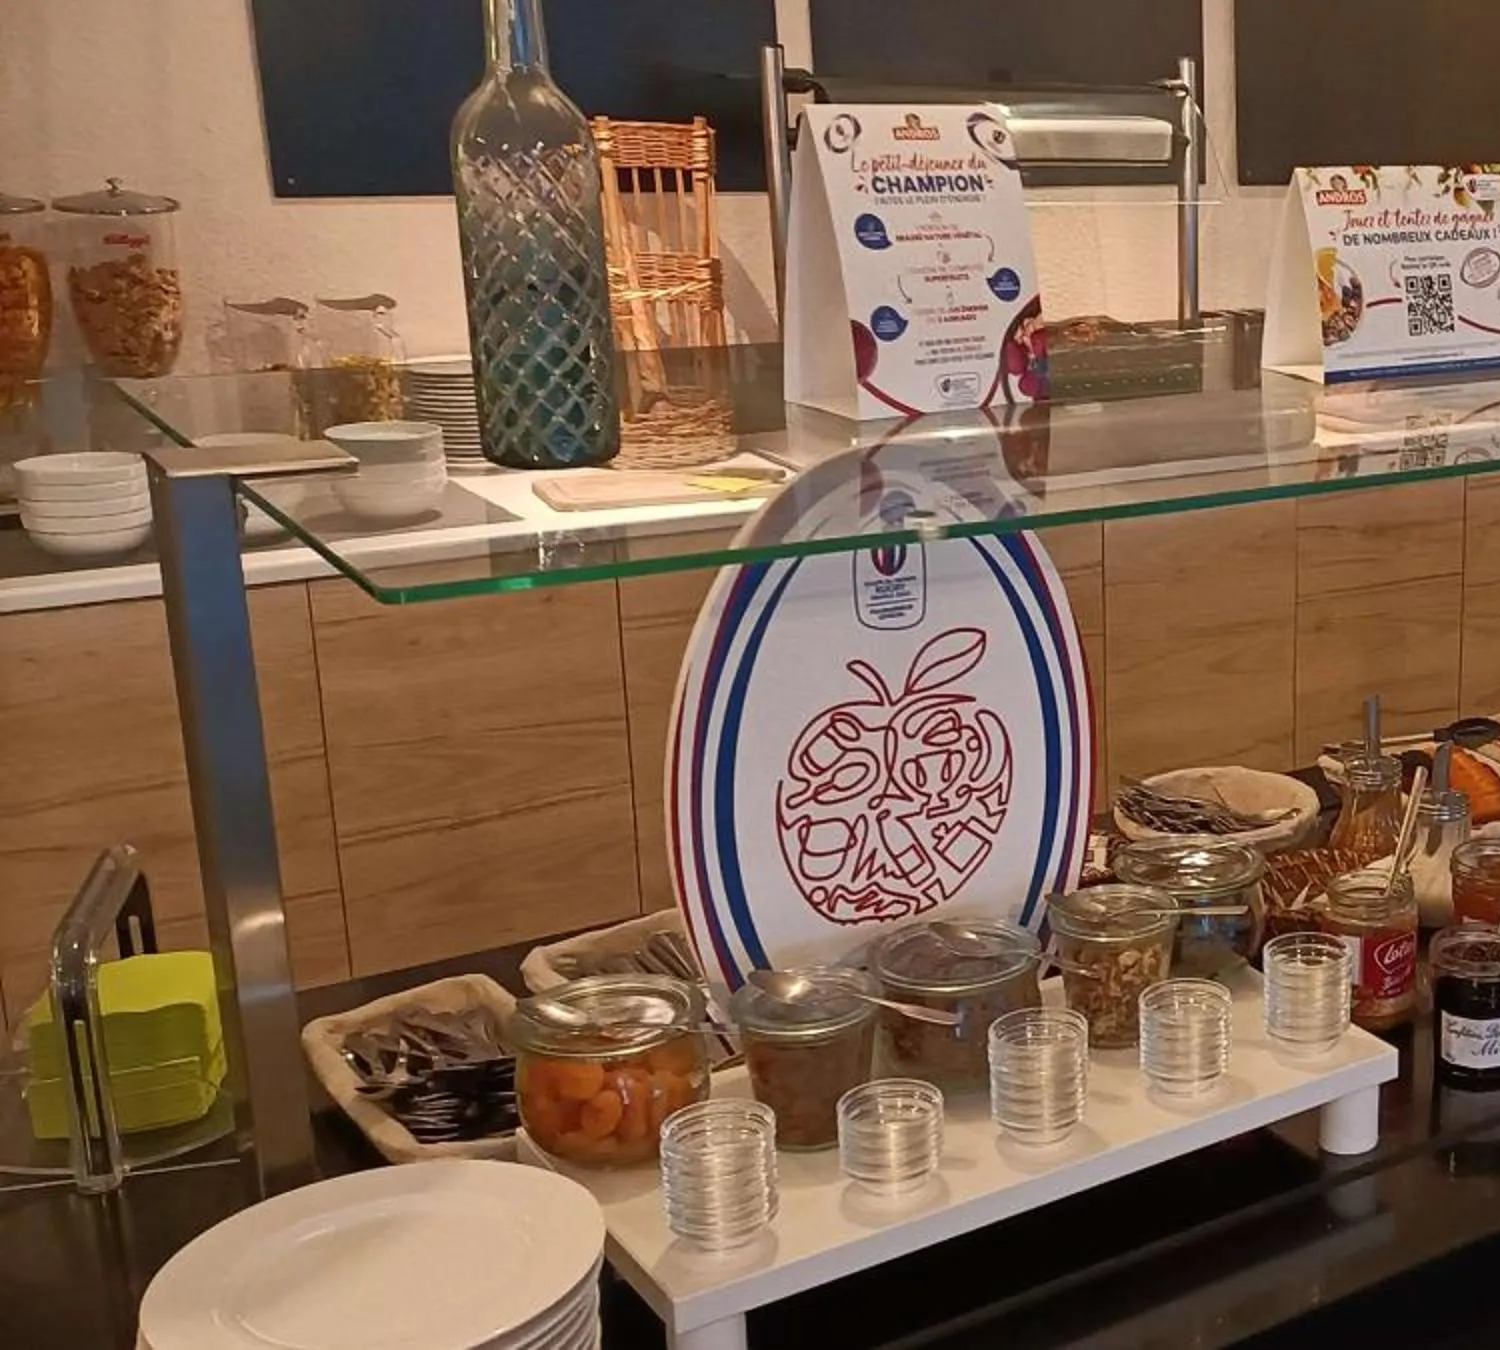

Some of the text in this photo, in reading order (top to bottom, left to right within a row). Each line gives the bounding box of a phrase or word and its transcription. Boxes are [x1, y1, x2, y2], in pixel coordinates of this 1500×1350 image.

[851, 151, 868, 173] Le
[968, 152, 988, 171] du
[871, 174, 985, 194] CHAMPION
[1318, 191, 1366, 204] ANDROS
[1343, 210, 1374, 231] Jouez
[1378, 208, 1392, 228] et
[1395, 207, 1432, 227] tentez
[1434, 210, 1448, 225] de
[1343, 233, 1360, 247] DE
[1363, 230, 1432, 245] NOMBREUX
[1435, 228, 1491, 242] CADEAUX
